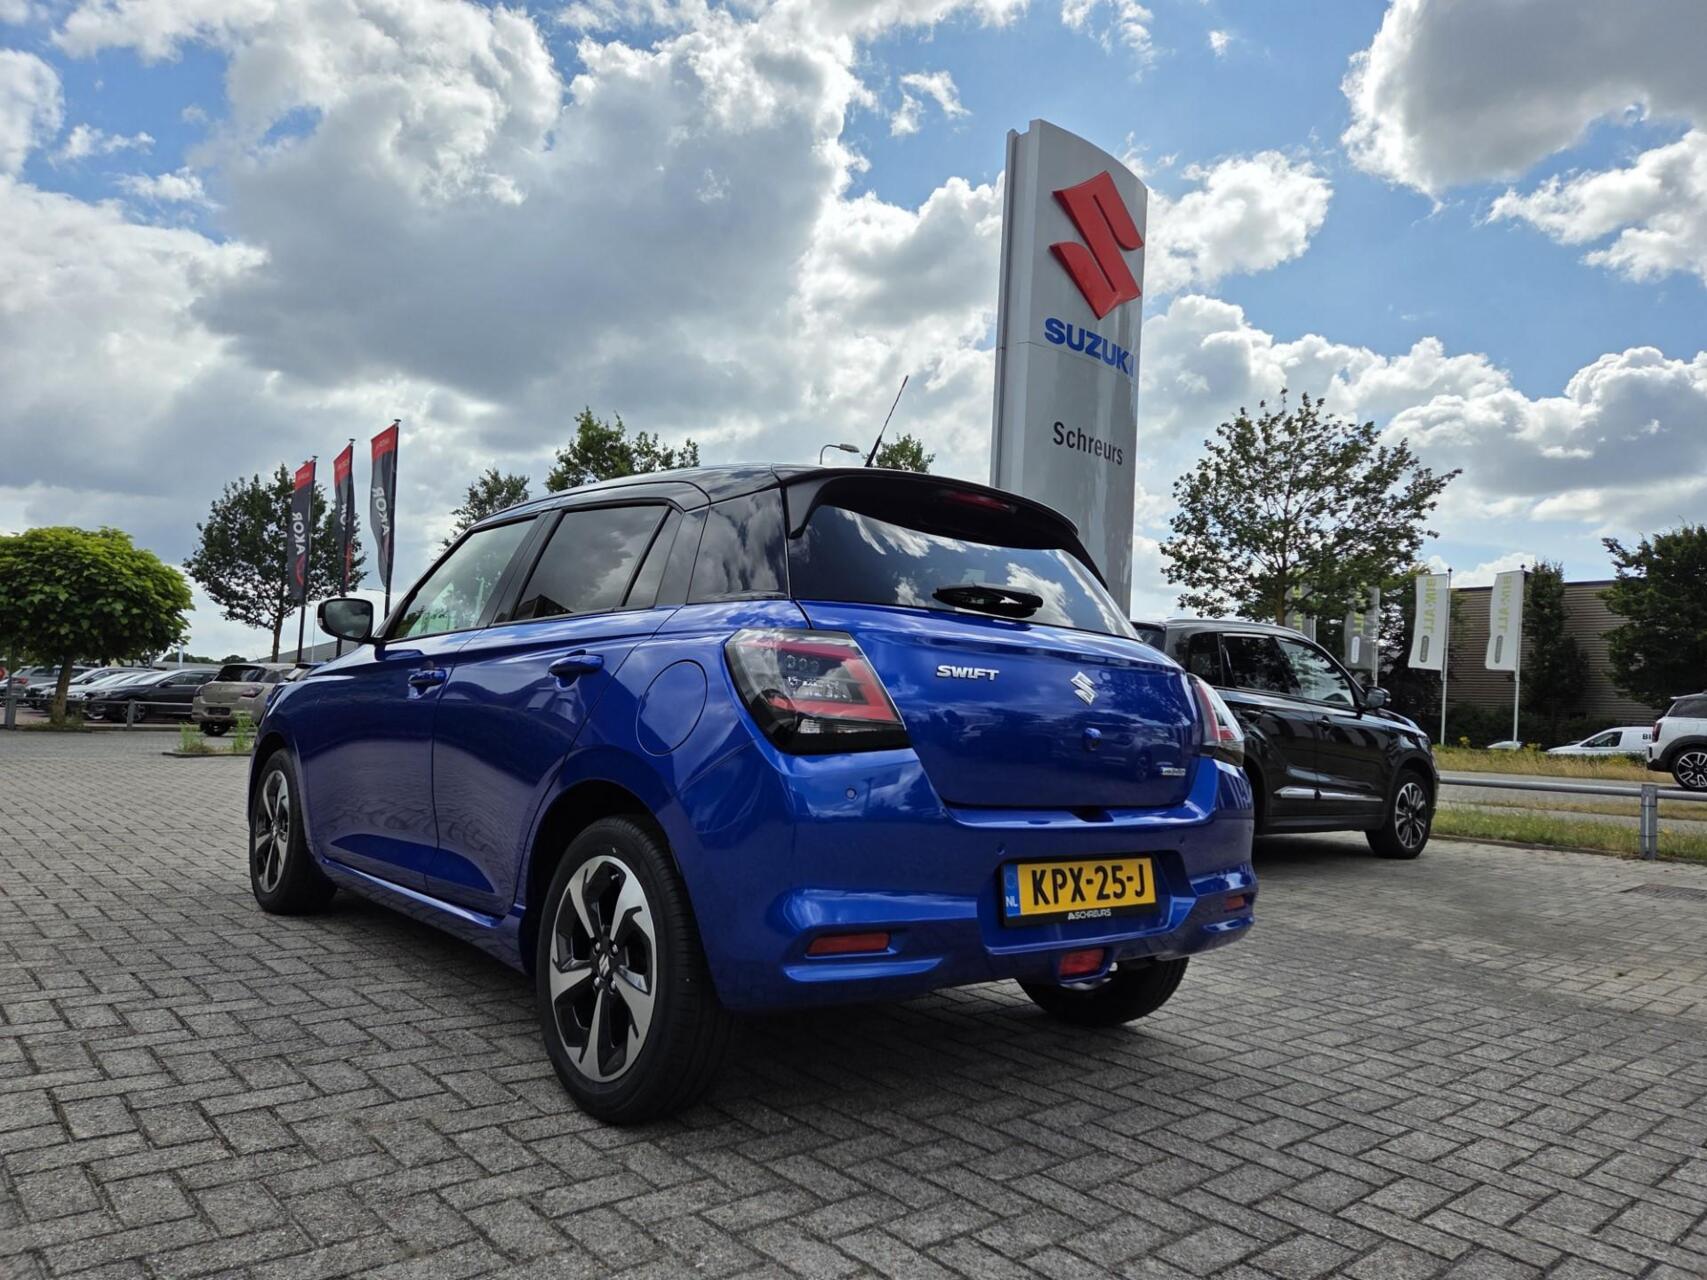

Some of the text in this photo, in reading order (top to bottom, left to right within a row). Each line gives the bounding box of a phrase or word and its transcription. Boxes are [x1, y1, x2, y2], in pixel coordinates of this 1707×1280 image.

[1044, 317, 1134, 378] SUZUKI
[1053, 421, 1123, 466] Schreurs
[936, 664, 1000, 681] SWIFT
[1005, 896, 1018, 907] NL
[1031, 863, 1146, 906] KPX-25-J
